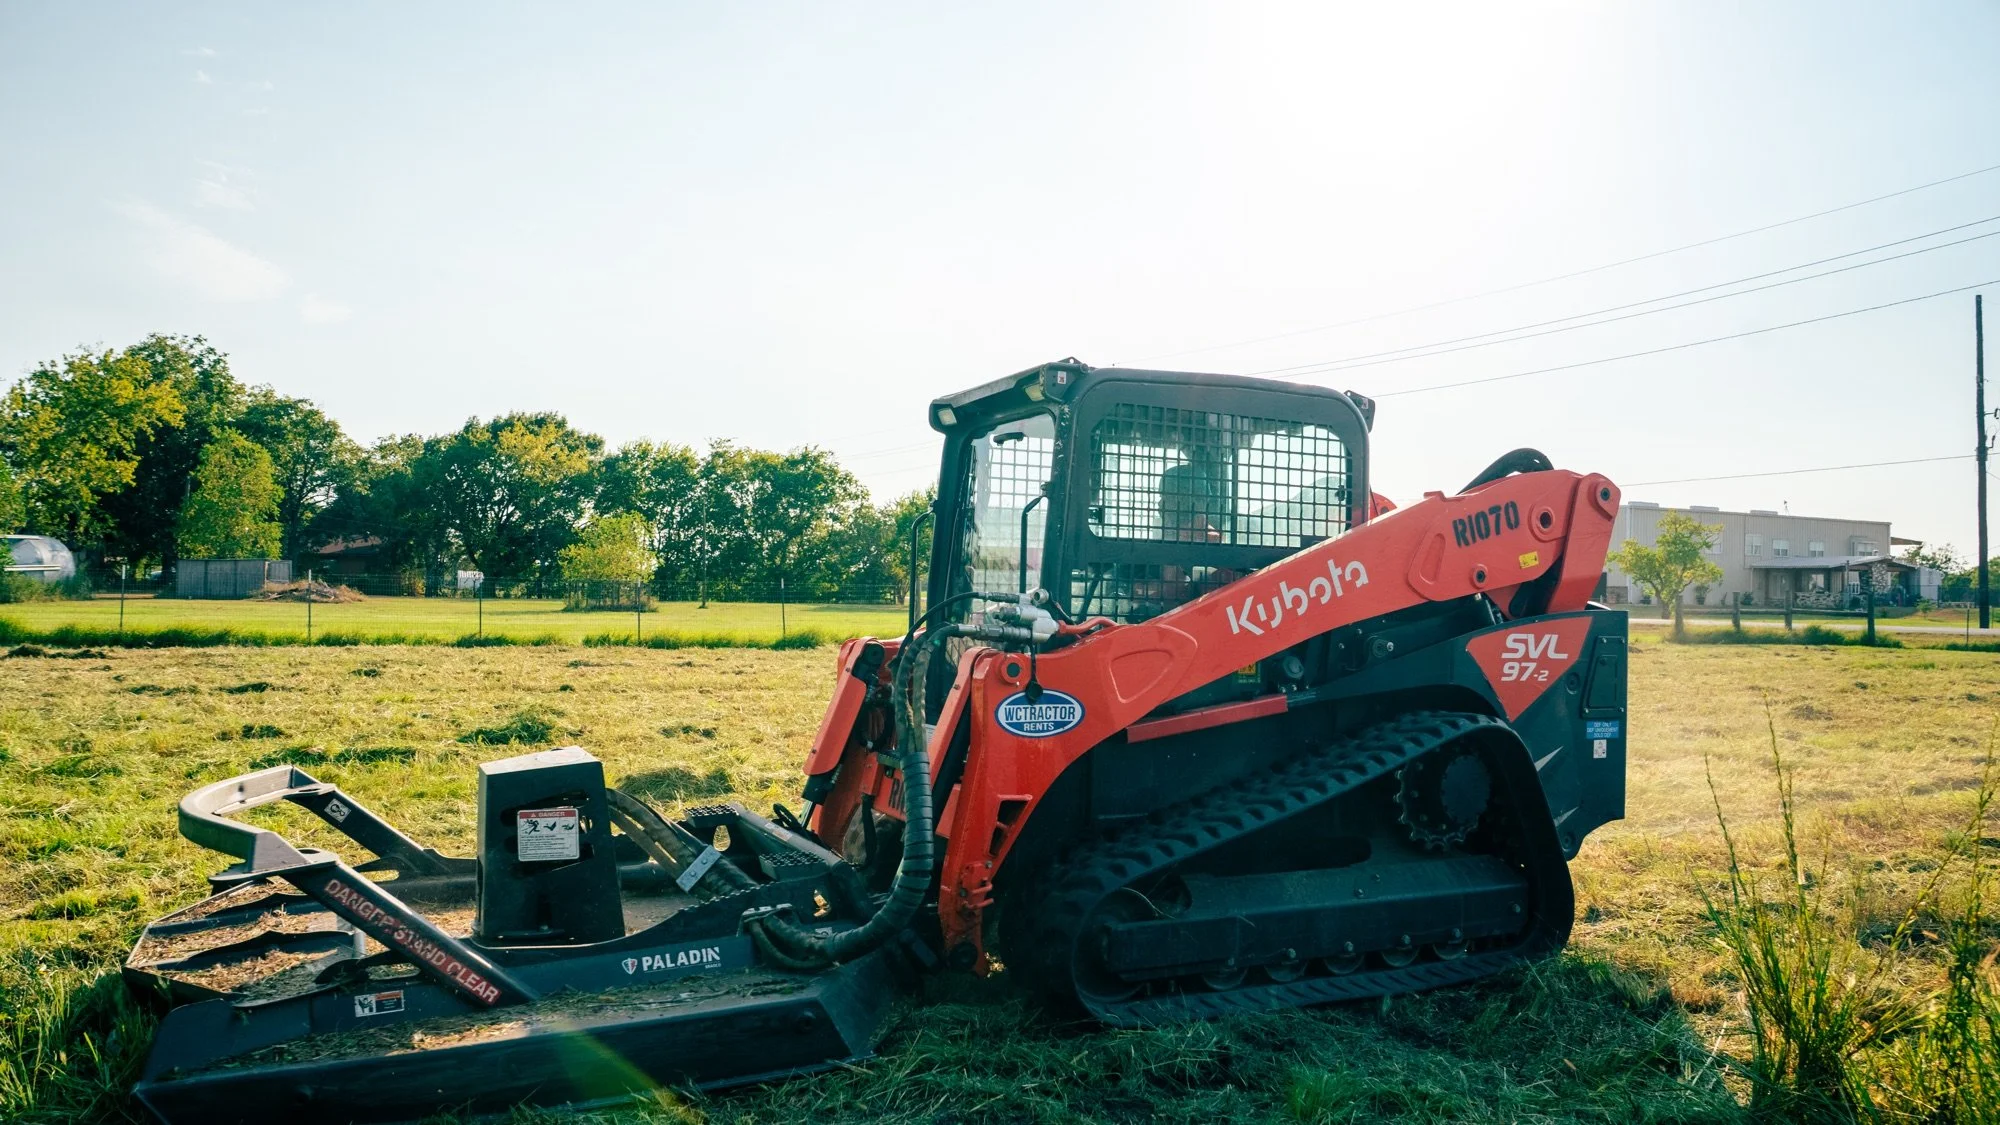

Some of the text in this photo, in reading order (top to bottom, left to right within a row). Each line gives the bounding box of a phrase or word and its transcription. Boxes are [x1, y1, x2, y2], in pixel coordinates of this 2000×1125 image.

[1226, 559, 1369, 636] Kubota
[1501, 633, 1569, 659] SVL
[1501, 661, 1549, 682] 97-2
[1004, 706, 1076, 721] WCTRACTOR
[1023, 722, 1055, 732] RENTS
[538, 811, 566, 819] DANGER
[641, 946, 720, 972] PALADIN
[447, 961, 499, 1004] CLEAR
